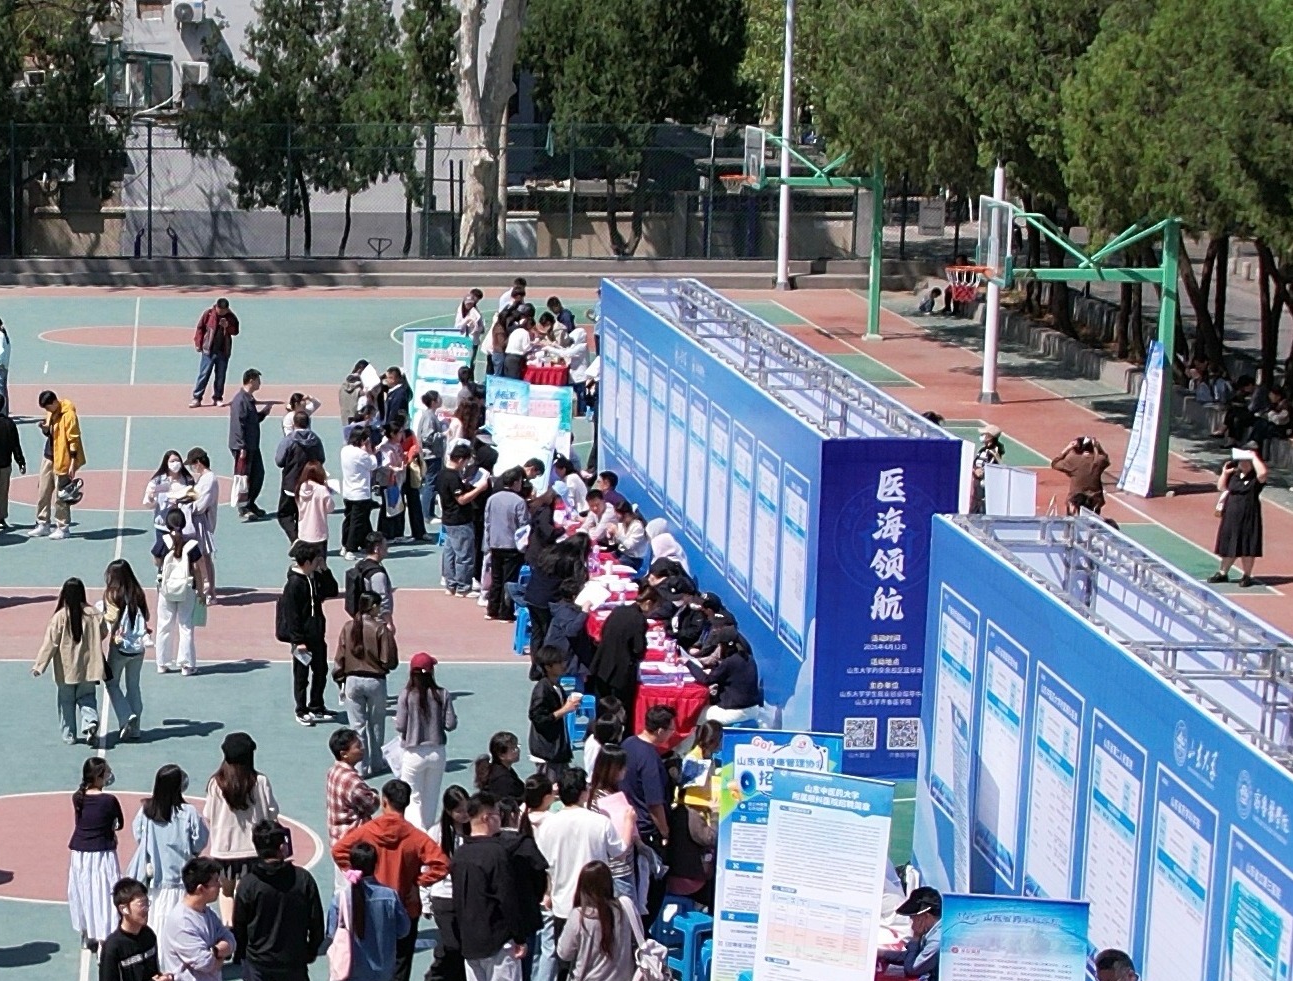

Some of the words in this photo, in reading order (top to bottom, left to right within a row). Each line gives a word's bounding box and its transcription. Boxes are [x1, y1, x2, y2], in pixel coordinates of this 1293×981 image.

[869, 467, 907, 621] 医海领航
[753, 737, 773, 751] Go!
